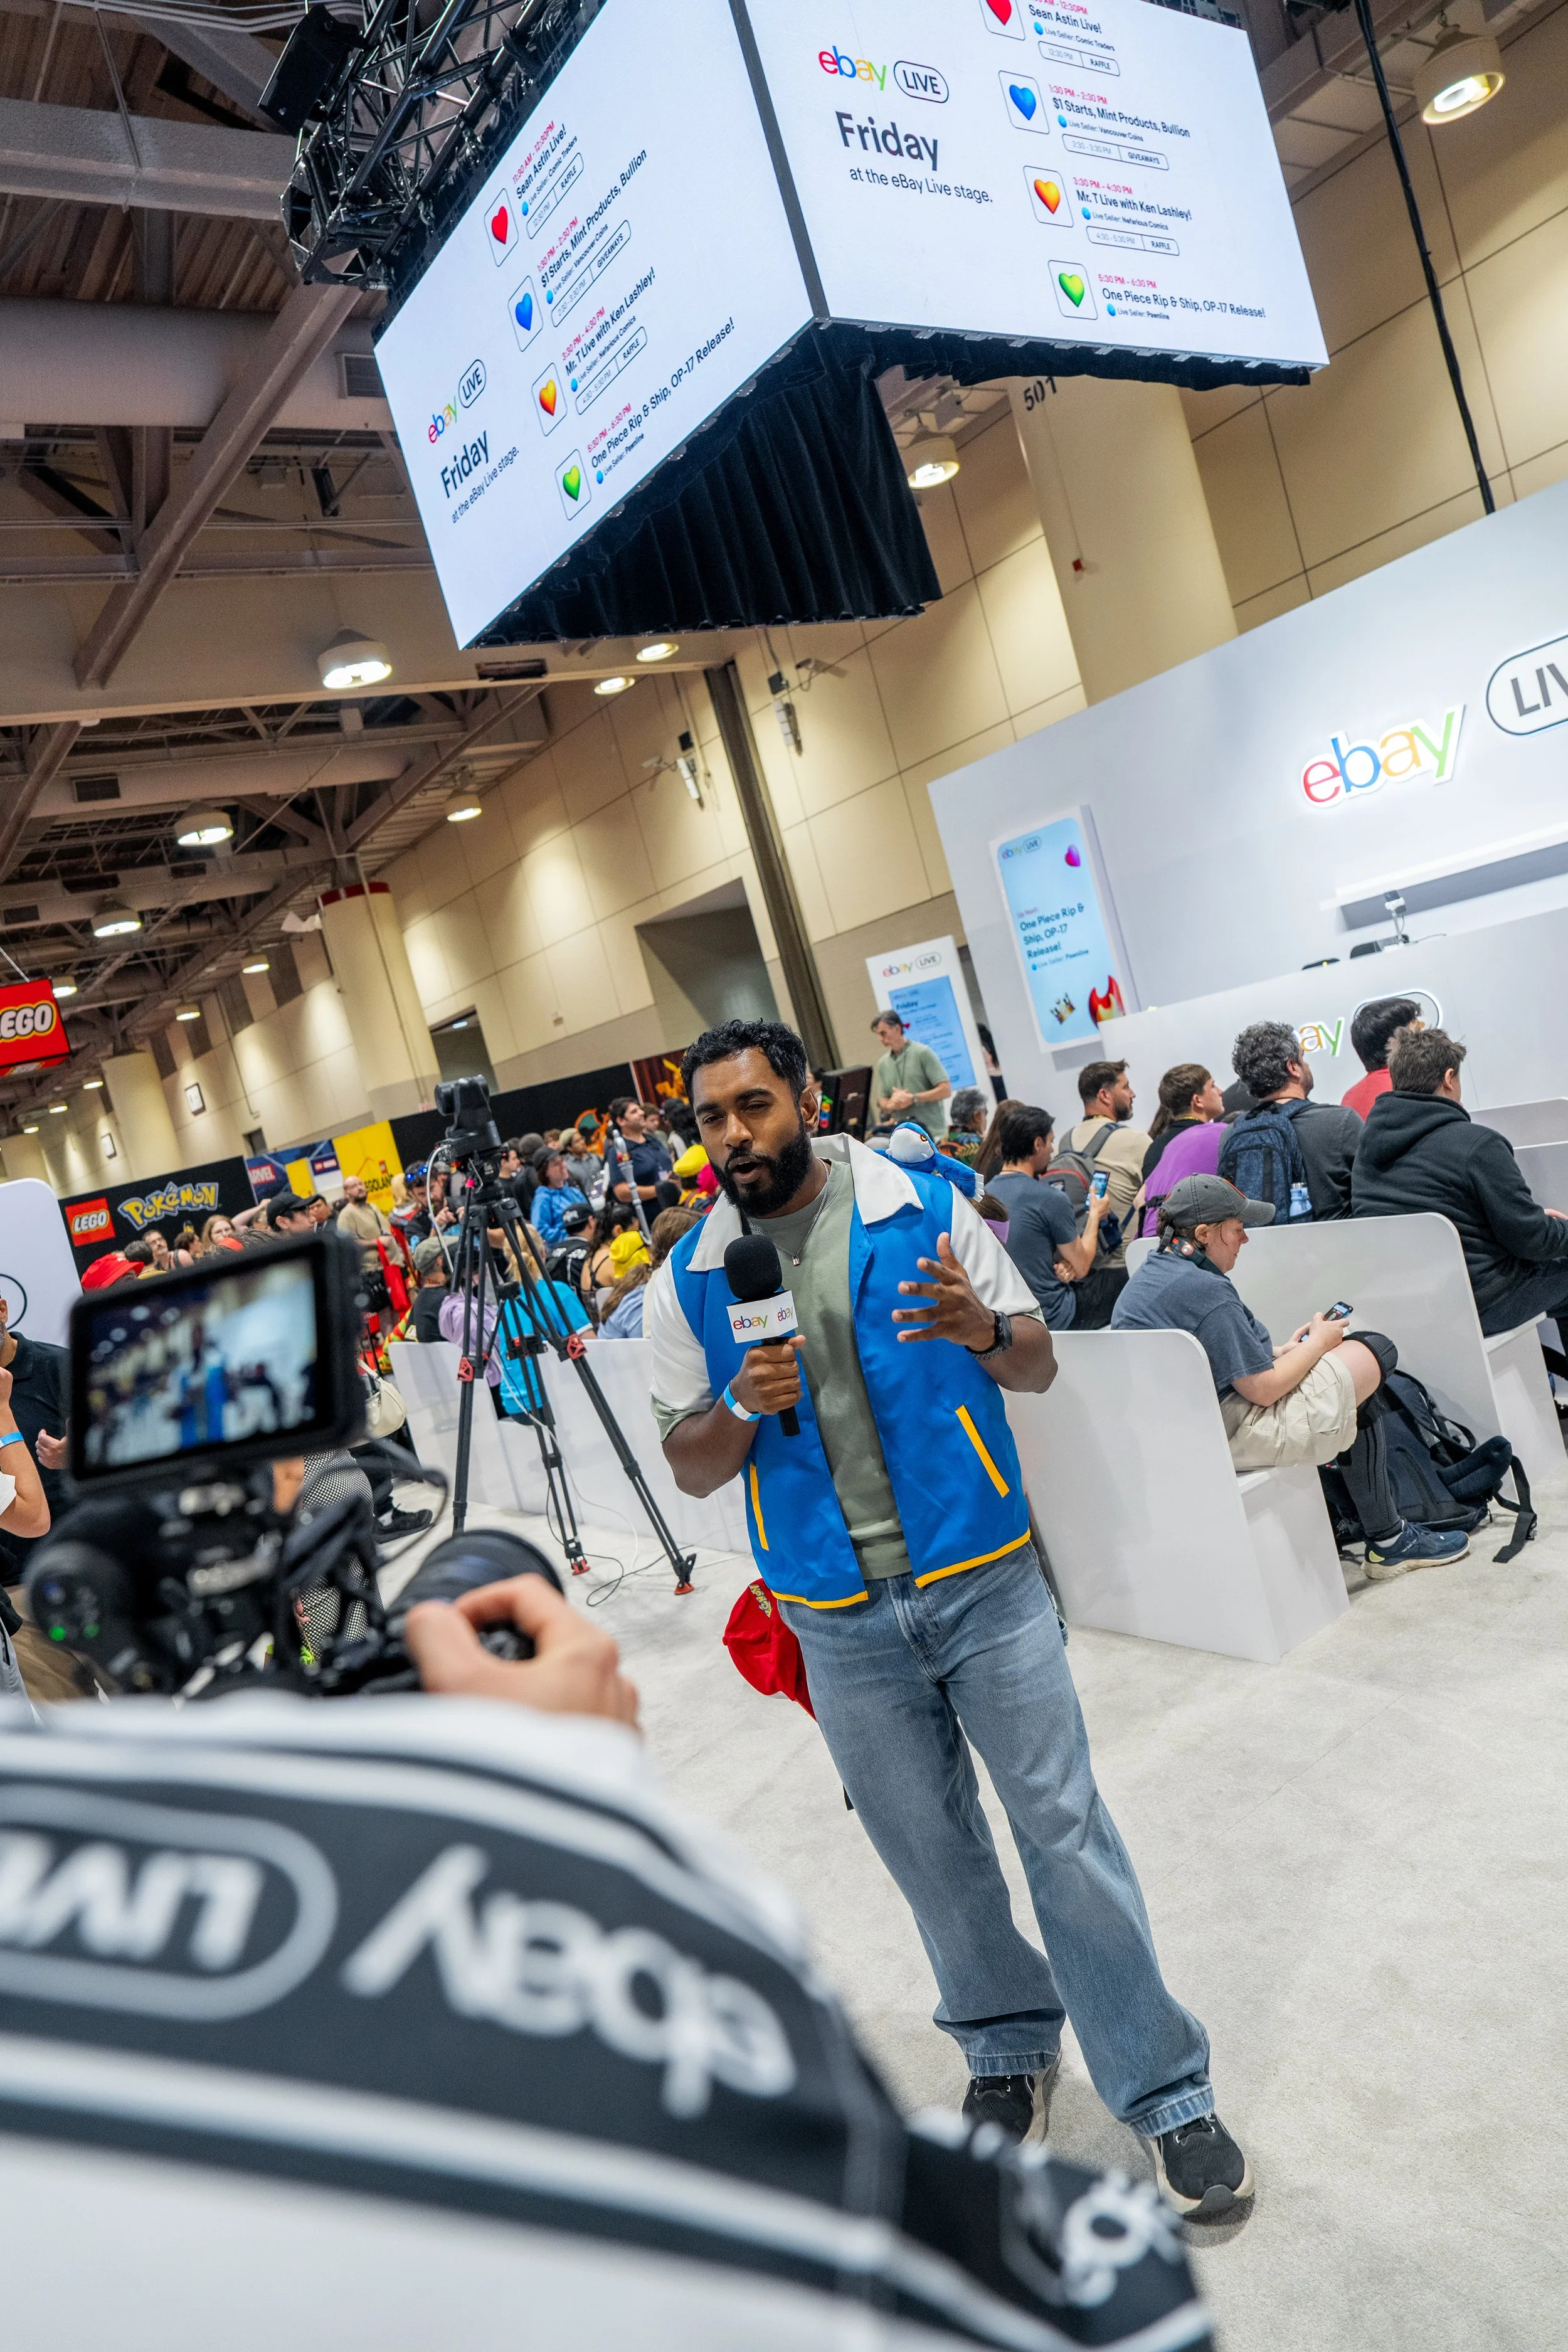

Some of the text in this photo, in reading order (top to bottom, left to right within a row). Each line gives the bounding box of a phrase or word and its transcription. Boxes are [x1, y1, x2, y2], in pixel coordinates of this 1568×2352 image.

[1029, 4, 1102, 34] Sean Astin Live!
[1060, 1, 1088, 14] 12:30PM
[1044, 28, 1115, 51] Live Seller: Comic Traders
[818, 45, 887, 91] ebay
[1090, 59, 1110, 70] RAFFLE
[903, 70, 941, 95] LIVE
[1049, 85, 1108, 105] 1:30 PM 2:30 PM
[1052, 97, 1190, 137] $1 Starts, Mint Products, Bullion
[1068, 120, 1143, 142] Live Seller: Vancouver Coins
[524, 153, 532, 166] AM
[534, 120, 554, 152] 12:30PM
[835, 111, 938, 171] Friday
[516, 124, 566, 199] Sean Astin Live!
[528, 135, 578, 206] Live Seller: Comic Traders
[1128, 152, 1160, 164] GIVEAWAYS
[560, 165, 577, 190] RAFFLE
[850, 167, 993, 204] at the eBay Live stage.
[1073, 177, 1133, 195] 3:30 PM 4:30 PM
[541, 149, 647, 288] $1 Starts, Mint Products, Bullion
[1077, 190, 1192, 221] Mr. T Live with Ken Lashley!
[1093, 211, 1168, 231] Live Seller: Nefarious Comics
[538, 216, 579, 272] 1:30 PM 2:30 PM
[553, 224, 608, 295] Live Seller: Vancouver Coins
[597, 233, 624, 268] GIVEAWAYS
[1151, 241, 1171, 250] RAFFLE
[1098, 274, 1157, 289] 5:30 PM 6:30 PM
[1103, 289, 1266, 318] One Piece Rip & Ship, OP-17 Release!
[1117, 307, 1170, 320] Live Seller: Pawnline
[563, 307, 606, 361] 3:30 PM 4:30 PM
[565, 266, 655, 376] Mr. T Live with Ken Lashley!
[578, 315, 636, 383] Live Seller: Nefarious Comics
[623, 338, 640, 360] RAFFLE
[462, 367, 483, 401] LIVE
[591, 317, 735, 468] One Piece Rip & Ship, OP-17 Release!
[1024, 376, 1057, 411] 501
[428, 395, 457, 443] ebay
[598, 428, 608, 440] PM
[611, 411, 623, 429] 6:30
[622, 403, 632, 416] PM
[440, 430, 489, 499] Friday
[603, 433, 645, 477] Live Seller: Pawnline
[452, 446, 520, 524] at the eBay Live stage.
[1510, 662, 1568, 718] LIV
[1303, 711, 1455, 803] ebay
[1026, 840, 1038, 849] LIVE
[1020, 903, 1084, 931] One Piece Rip &
[1044, 924, 1068, 938] OP-17
[919, 955, 936, 966] LIVE
[1027, 941, 1061, 959] Release!
[0, 1004, 53, 1039] EGO
[1300, 1020, 1342, 1056] ay
[364, 1175, 392, 1192] EGOLAN
[73, 1211, 107, 1232] LEGO
[733, 1315, 768, 1330] ebay
[778, 1306, 793, 1322] ebay
